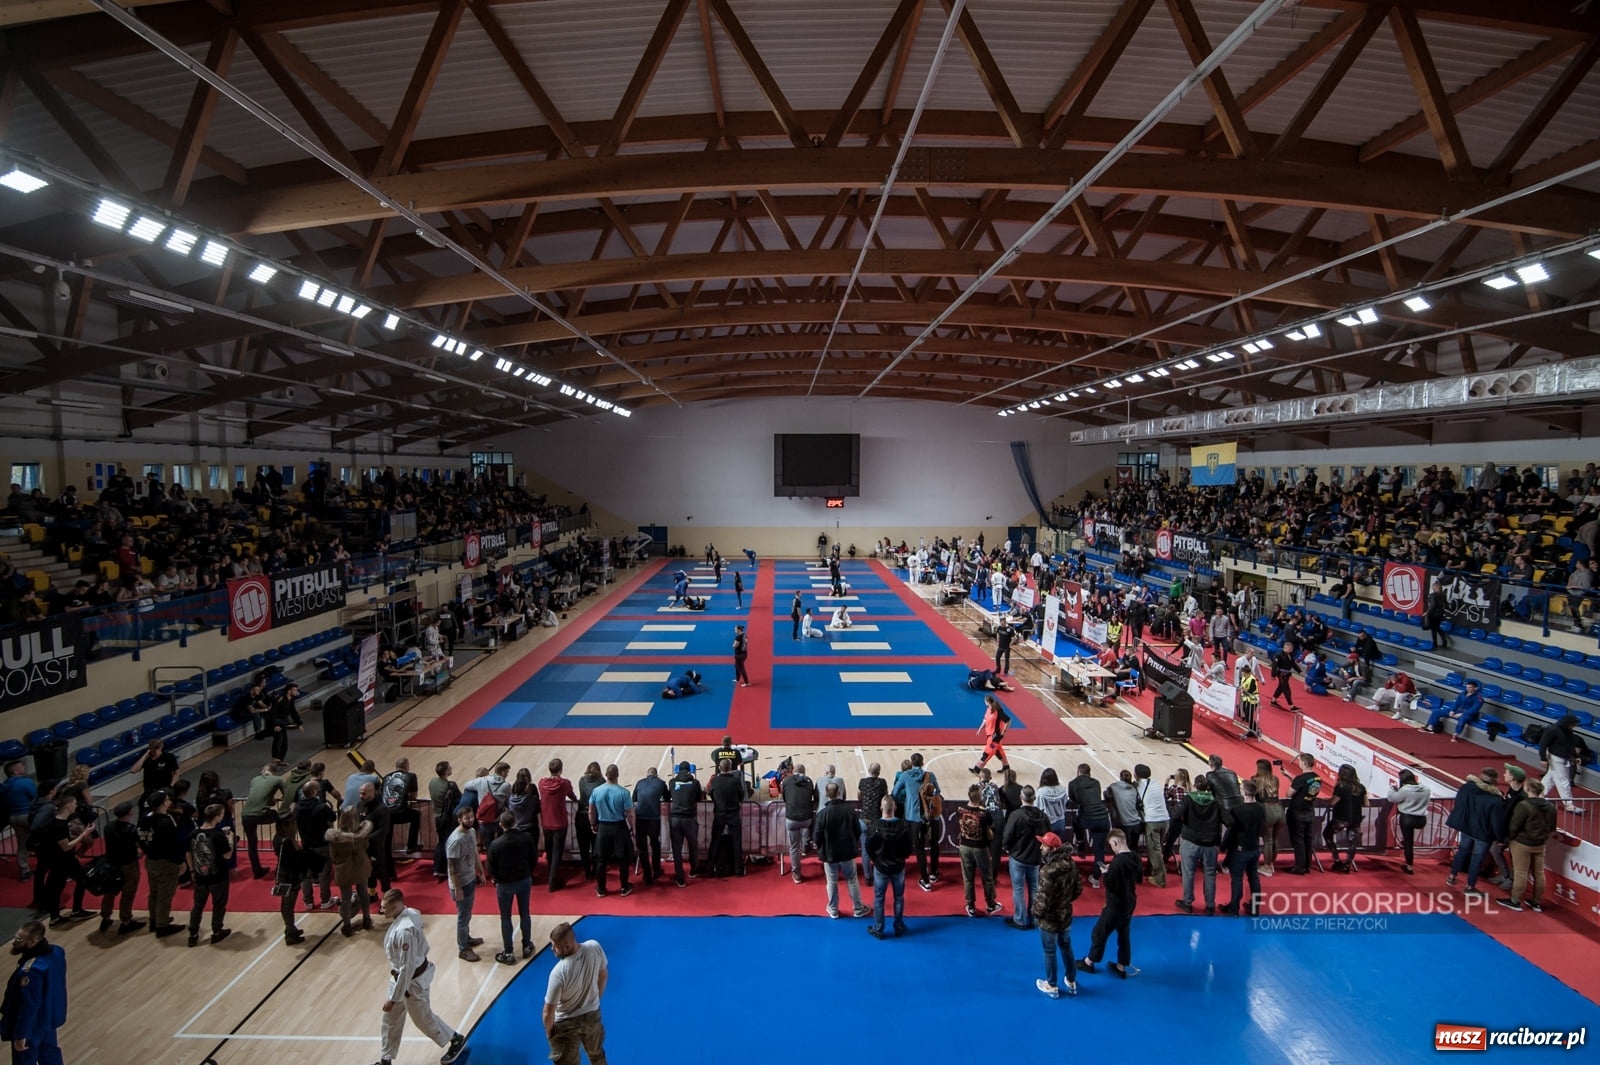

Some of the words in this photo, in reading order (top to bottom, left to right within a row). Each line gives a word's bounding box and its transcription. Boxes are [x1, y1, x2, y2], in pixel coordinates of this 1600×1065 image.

[480, 532, 506, 549] PITBULL
[1173, 534, 1209, 554] PITBULL
[274, 567, 342, 602] PITBULL
[0, 627, 75, 670] ULL
[0, 654, 76, 698] OAST
